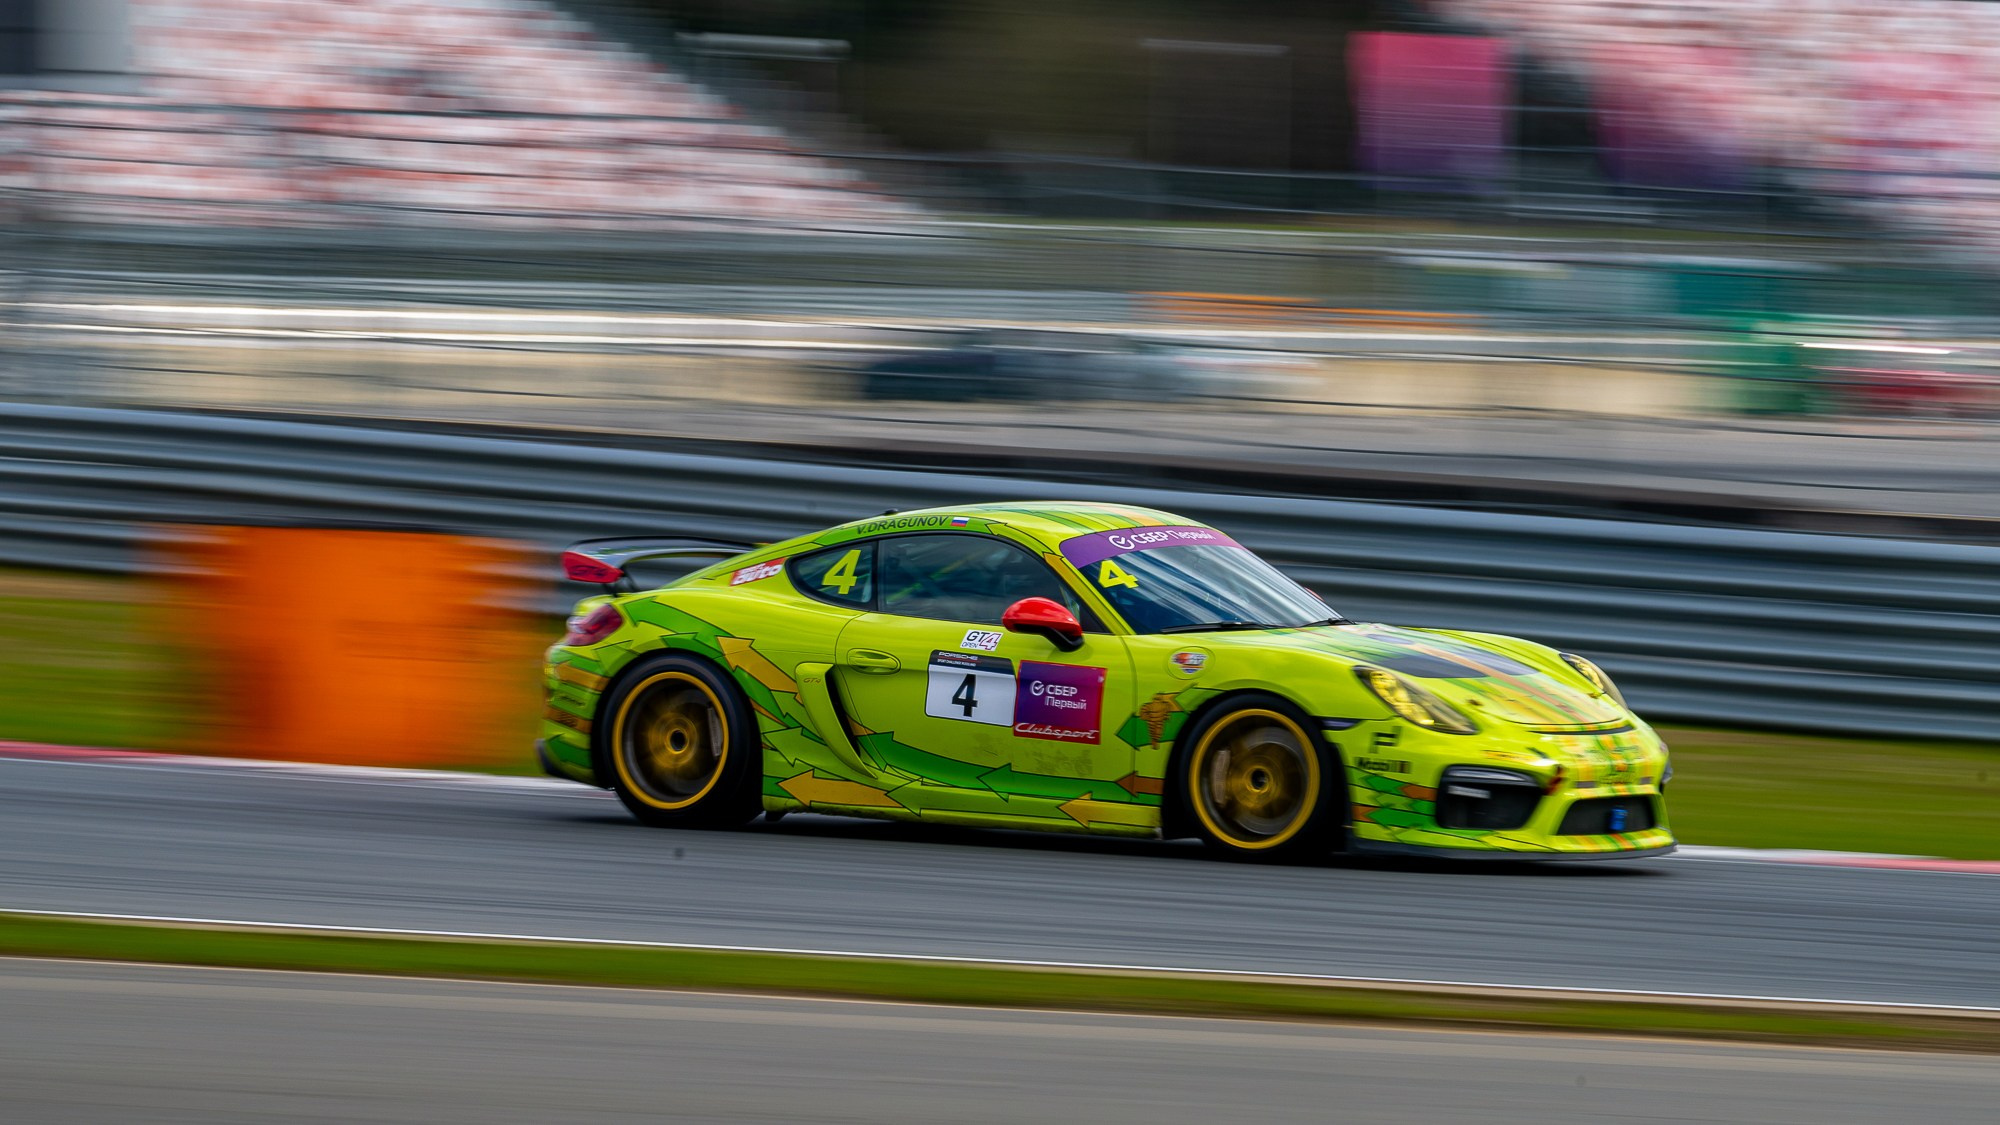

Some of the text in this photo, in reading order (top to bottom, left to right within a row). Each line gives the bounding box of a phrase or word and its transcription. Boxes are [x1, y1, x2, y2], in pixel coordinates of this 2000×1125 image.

[857, 516, 949, 534] V.DRAGUNOV
[1131, 531, 1169, 544] СБЕР
[822, 549, 861, 594] 4
[1098, 559, 1139, 588] 4
[966, 631, 1002, 650] GT4
[938, 651, 978, 660] PORSCHE
[952, 673, 978, 717] 4
[1045, 684, 1078, 696] СБЕР
[1044, 696, 1087, 710] Первый
[1015, 722, 1100, 739] Clubsport
